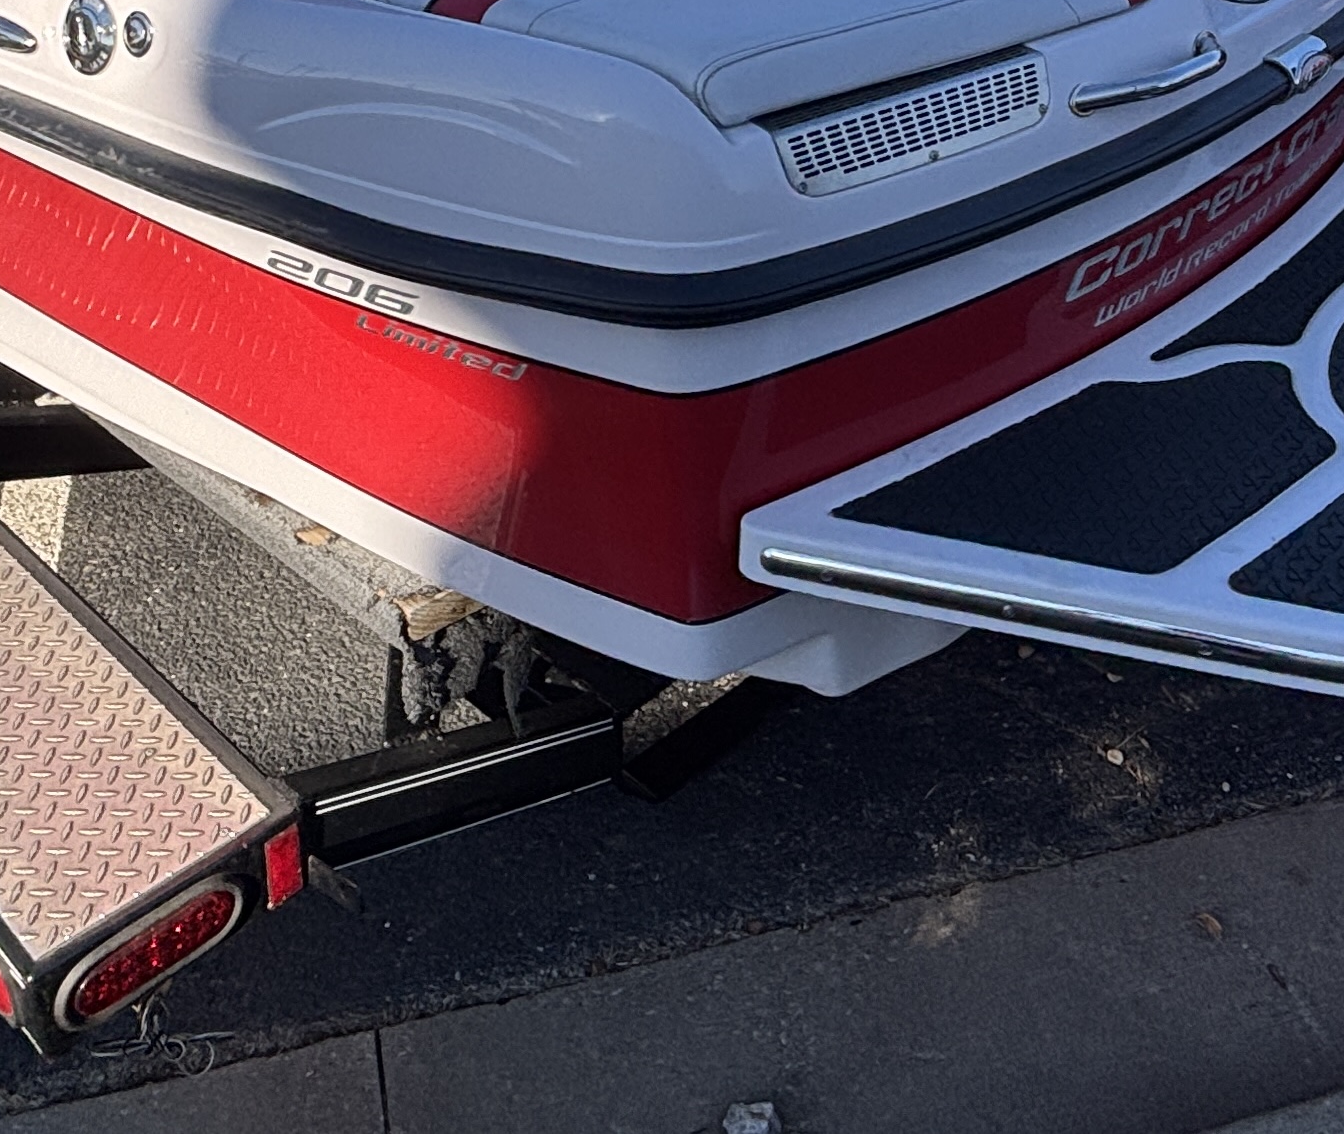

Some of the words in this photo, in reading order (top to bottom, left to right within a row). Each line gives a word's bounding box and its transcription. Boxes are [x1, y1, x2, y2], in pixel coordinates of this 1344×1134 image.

[1065, 140, 1282, 304] Correct
[266, 249, 420, 316] 206
[1094, 260, 1181, 328] World
[356, 315, 529, 382] Limited
